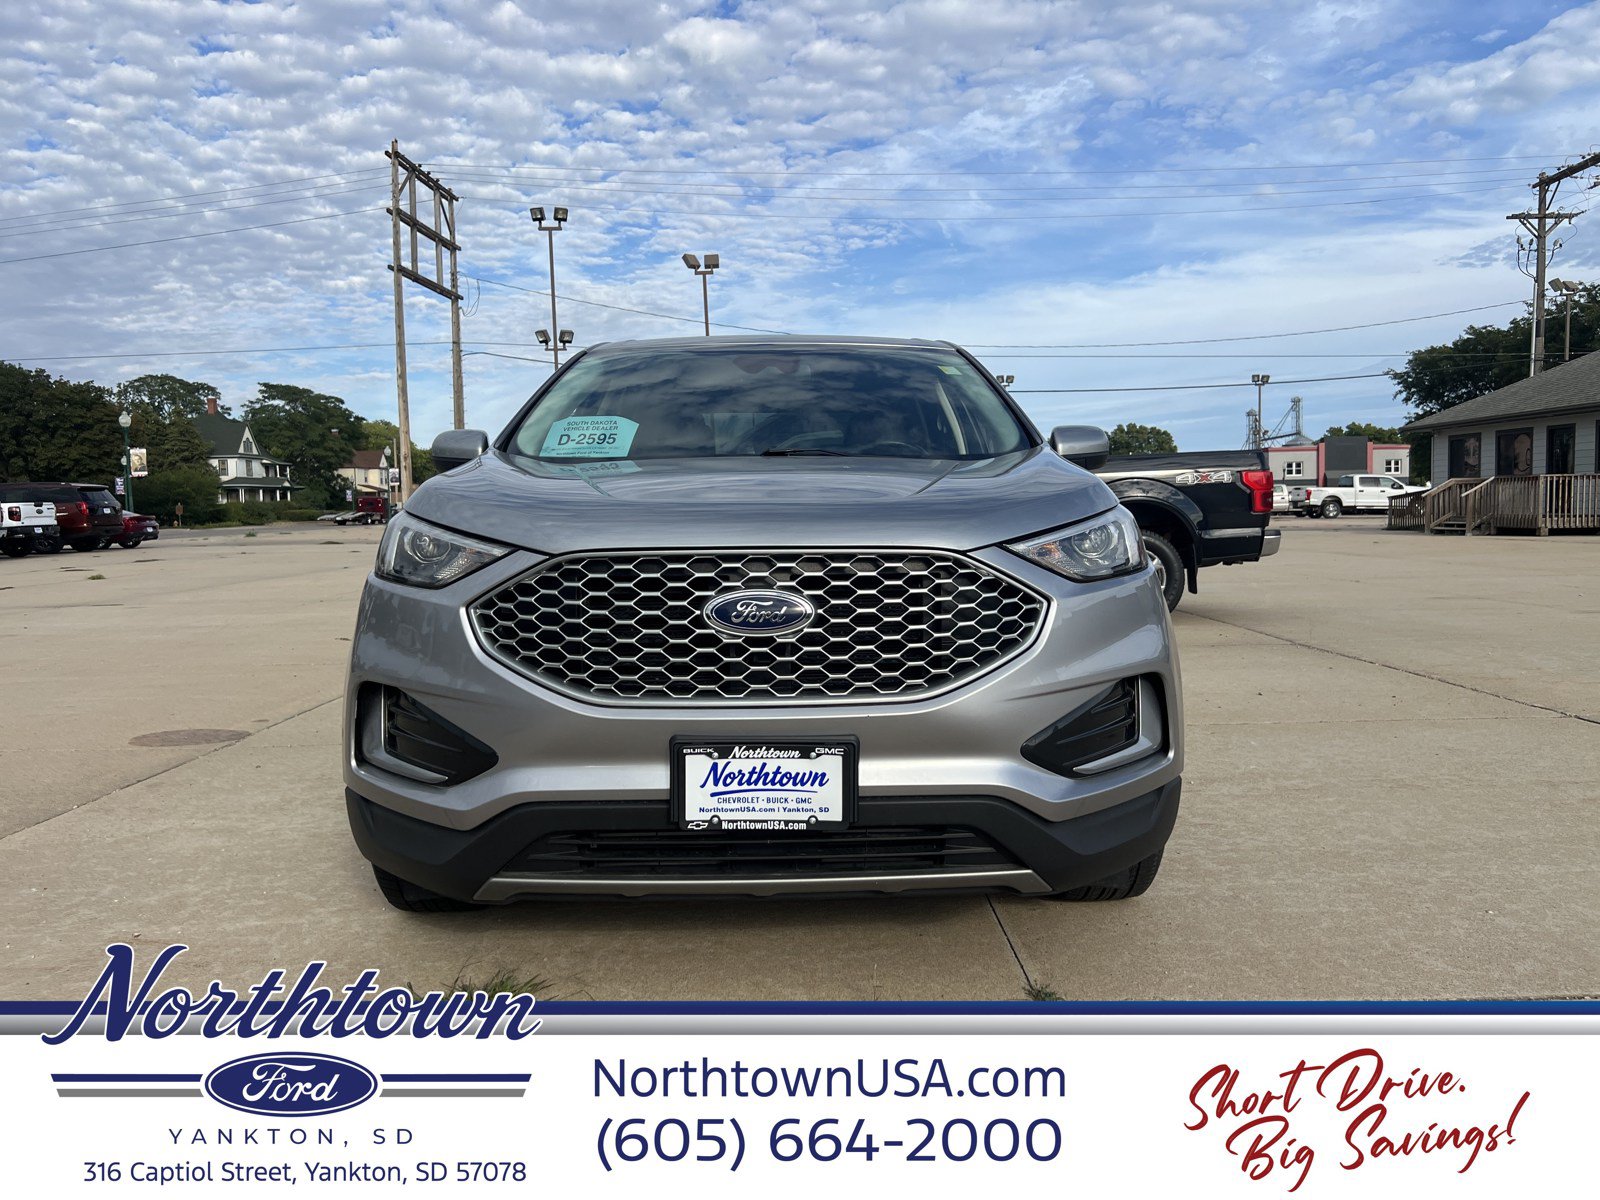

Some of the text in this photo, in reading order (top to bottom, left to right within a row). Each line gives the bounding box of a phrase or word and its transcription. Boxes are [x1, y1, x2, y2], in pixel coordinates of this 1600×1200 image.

[557, 433, 618, 446] D-2595
[731, 600, 788, 623] Ford
[728, 746, 801, 759] Northtown
[815, 747, 844, 755] GMC
[700, 761, 829, 788] Northtown
[782, 806, 816, 814] Yankton,
[721, 821, 807, 830] NorthtownUSA.com
